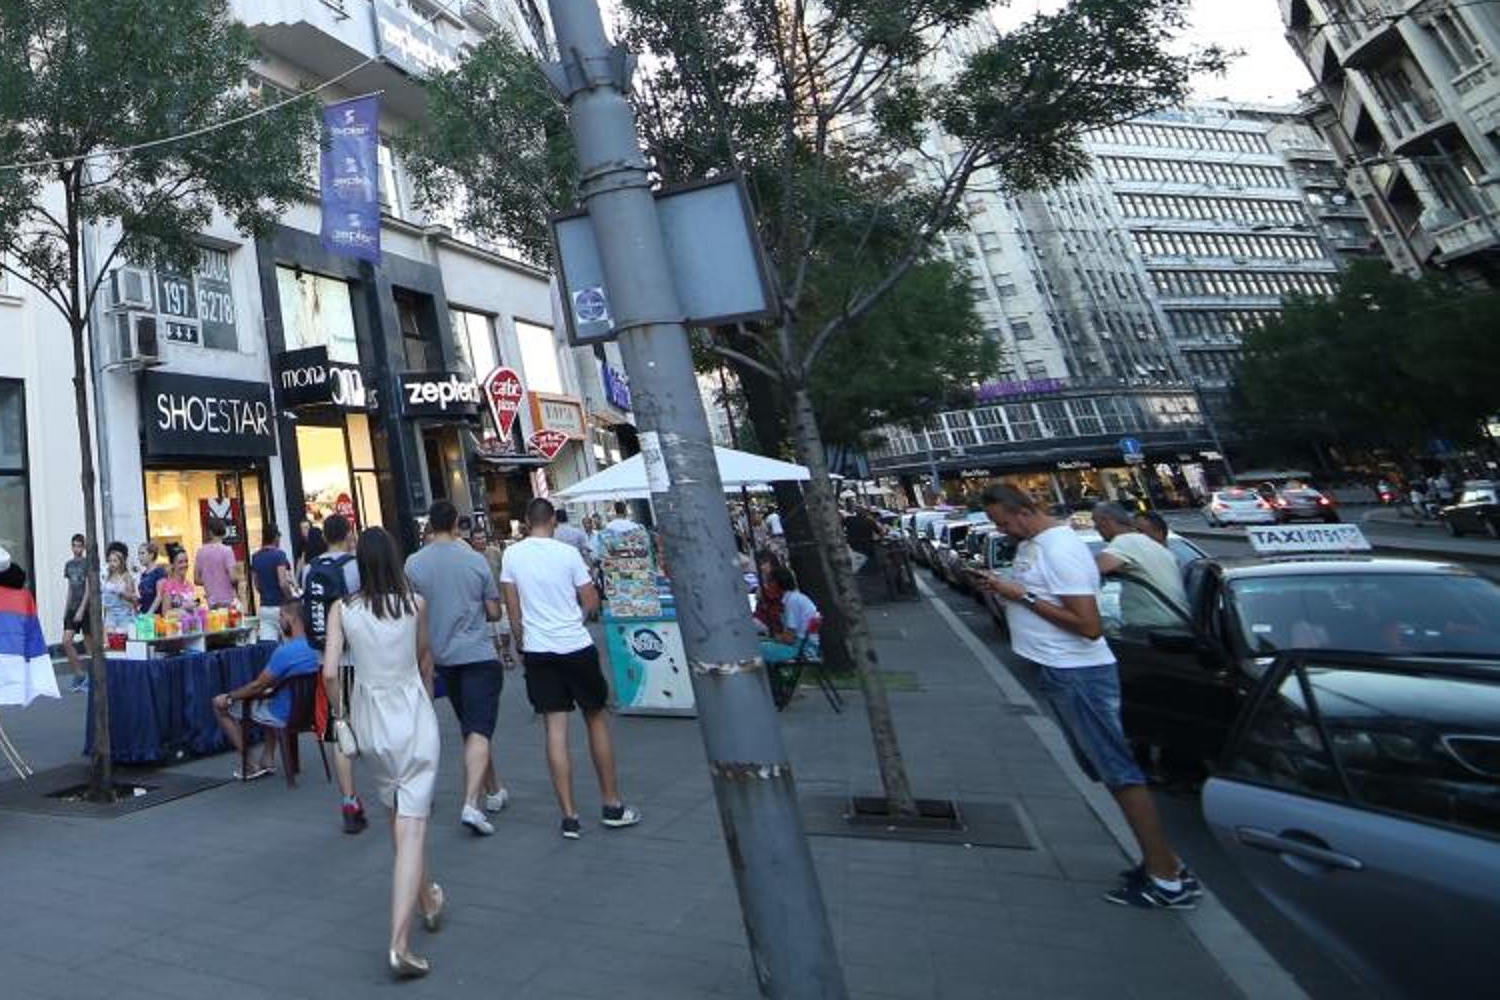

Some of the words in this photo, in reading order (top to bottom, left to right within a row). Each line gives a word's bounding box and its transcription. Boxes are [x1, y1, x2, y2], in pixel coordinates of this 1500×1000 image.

[163, 280, 189, 316] 197
[199, 289, 234, 325] 6278
[281, 365, 327, 389] mona
[156, 393, 270, 436] SHOESTAR
[1252, 530, 1305, 544] TAXI
